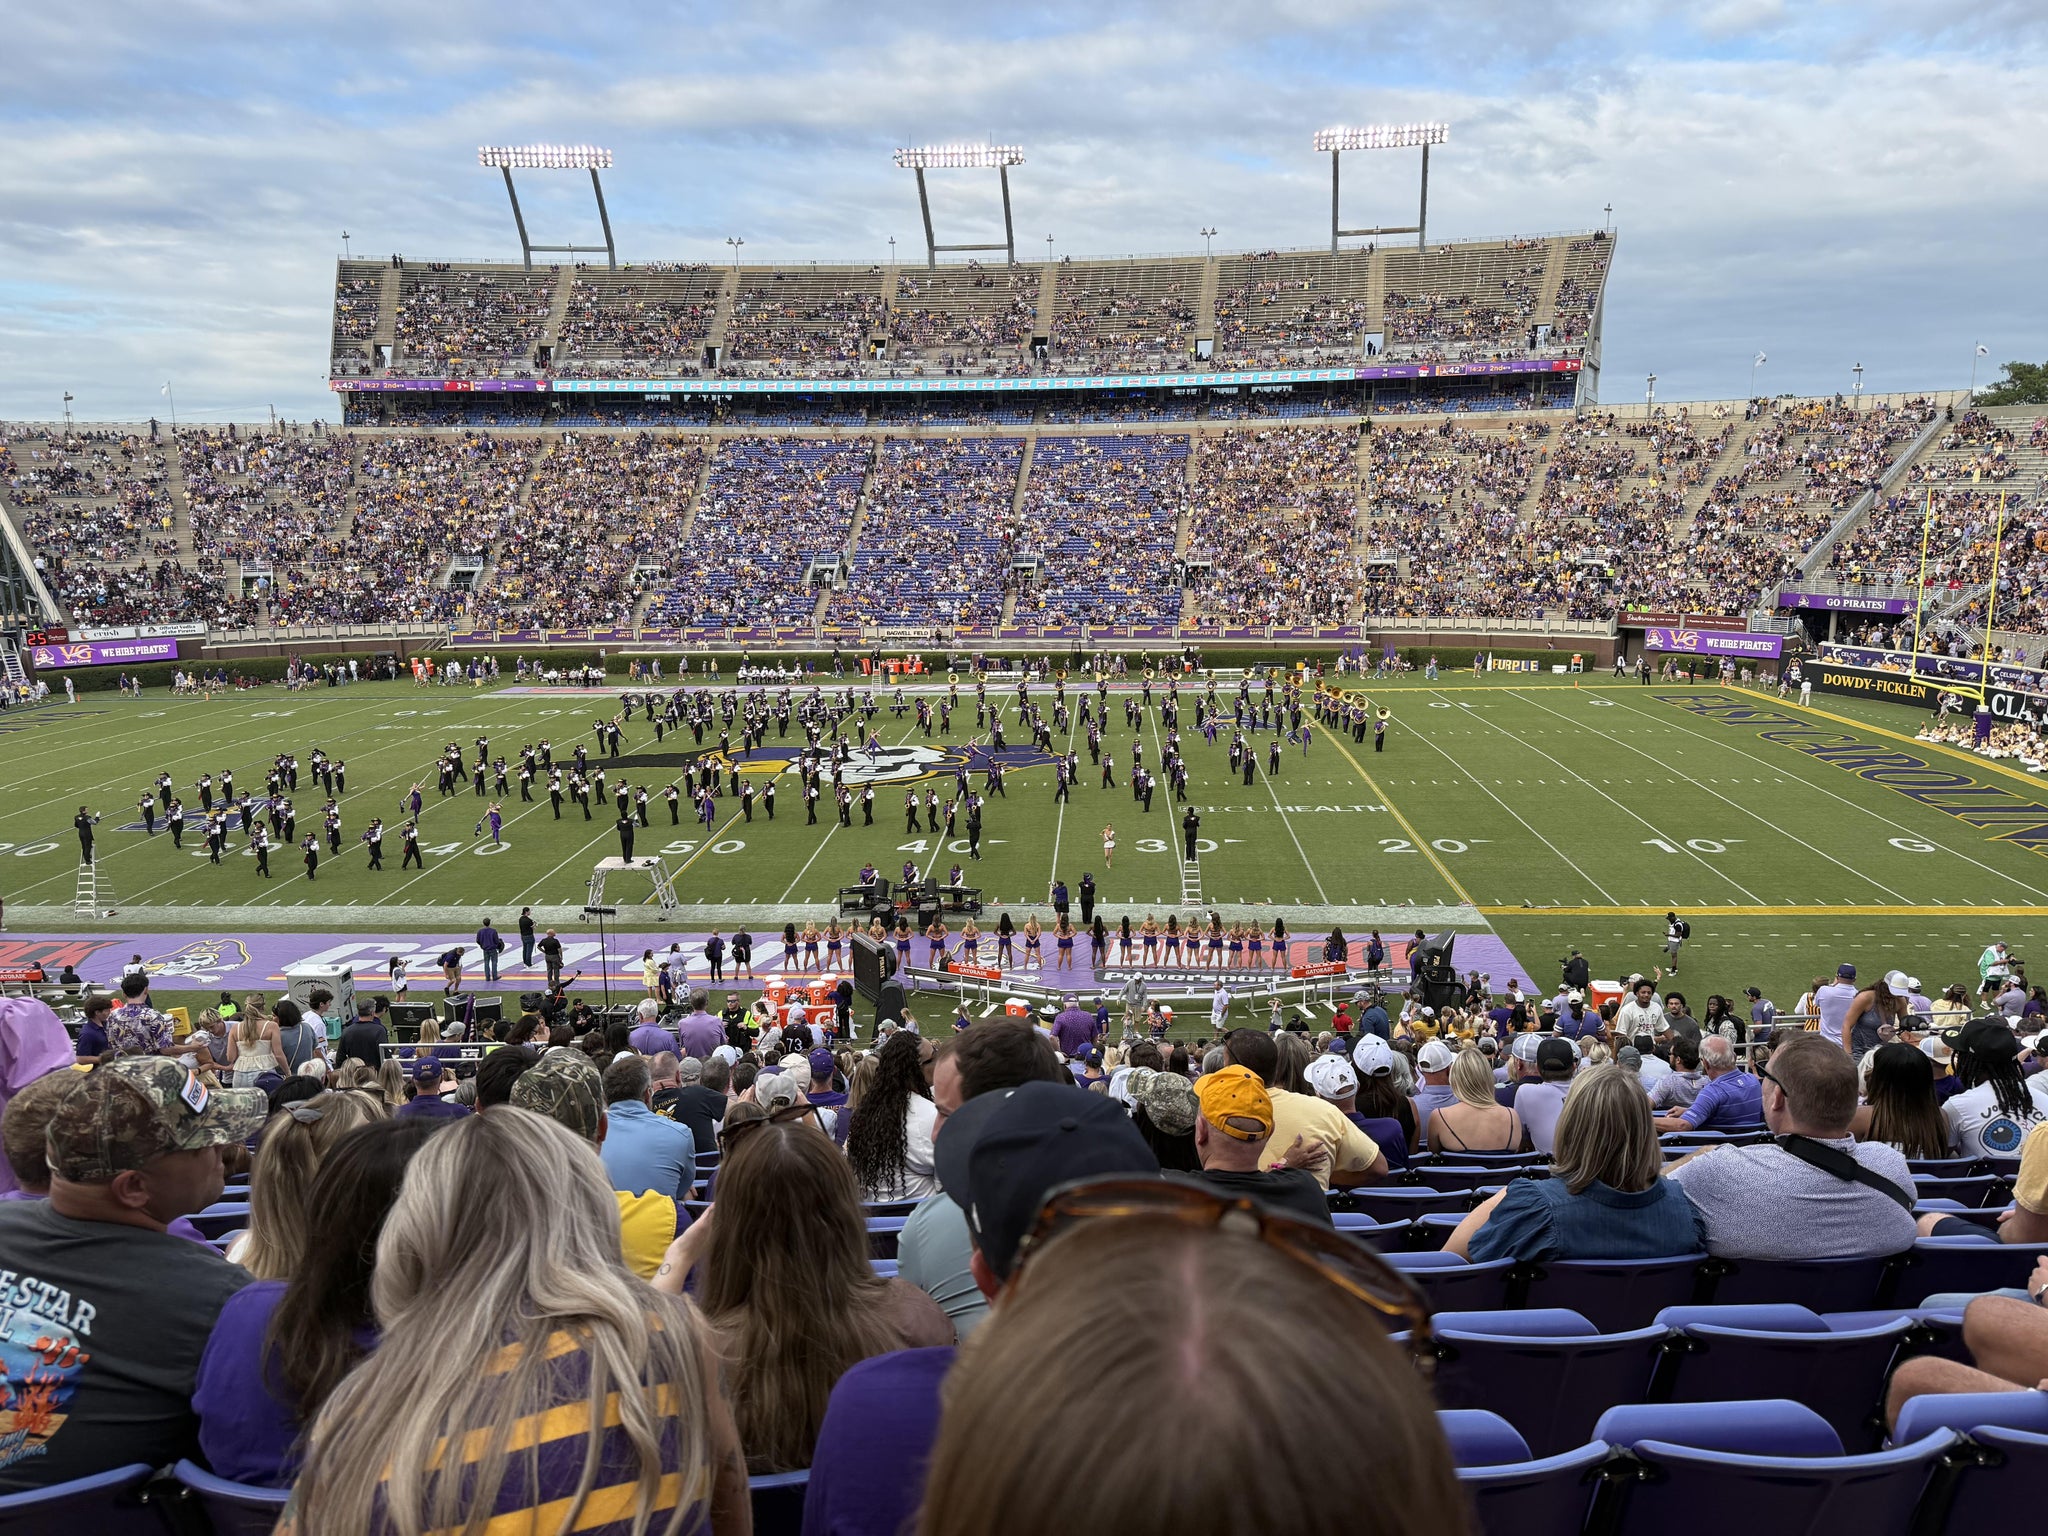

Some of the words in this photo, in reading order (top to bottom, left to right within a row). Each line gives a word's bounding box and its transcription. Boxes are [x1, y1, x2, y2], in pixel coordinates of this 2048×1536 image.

[1448, 366, 1459, 374] 42
[342, 381, 354, 389] 42
[1826, 598, 1840, 606] GO
[1843, 599, 1886, 609] PIRATES!
[28, 633, 47, 645] 25
[1706, 638, 1719, 648] WE
[1719, 639, 1739, 649] HIRE
[1740, 640, 1773, 651] PIRATES
[100, 648, 115, 657] WE
[115, 647, 135, 657] HIRE
[135, 645, 169, 655] PIRATES
[1492, 658, 1538, 671] PURPLE
[1823, 673, 1926, 699] DOWDY-FICKLEN
[1642, 692, 1818, 728] EAST
[422, 842, 510, 857] 40
[659, 840, 746, 854] 50
[896, 839, 980, 853] 40
[1135, 839, 1219, 853] 30
[1378, 839, 1468, 853] 20
[1641, 838, 1728, 854] 10
[1888, 838, 1935, 853] G
[189, 945, 230, 953] ECU
[958, 967, 988, 977] GATORADE
[1305, 966, 1335, 975] GATORADE
[814, 989, 820, 997] G
[786, 1037, 802, 1052] 73
[13, 1277, 96, 1336] STAR
